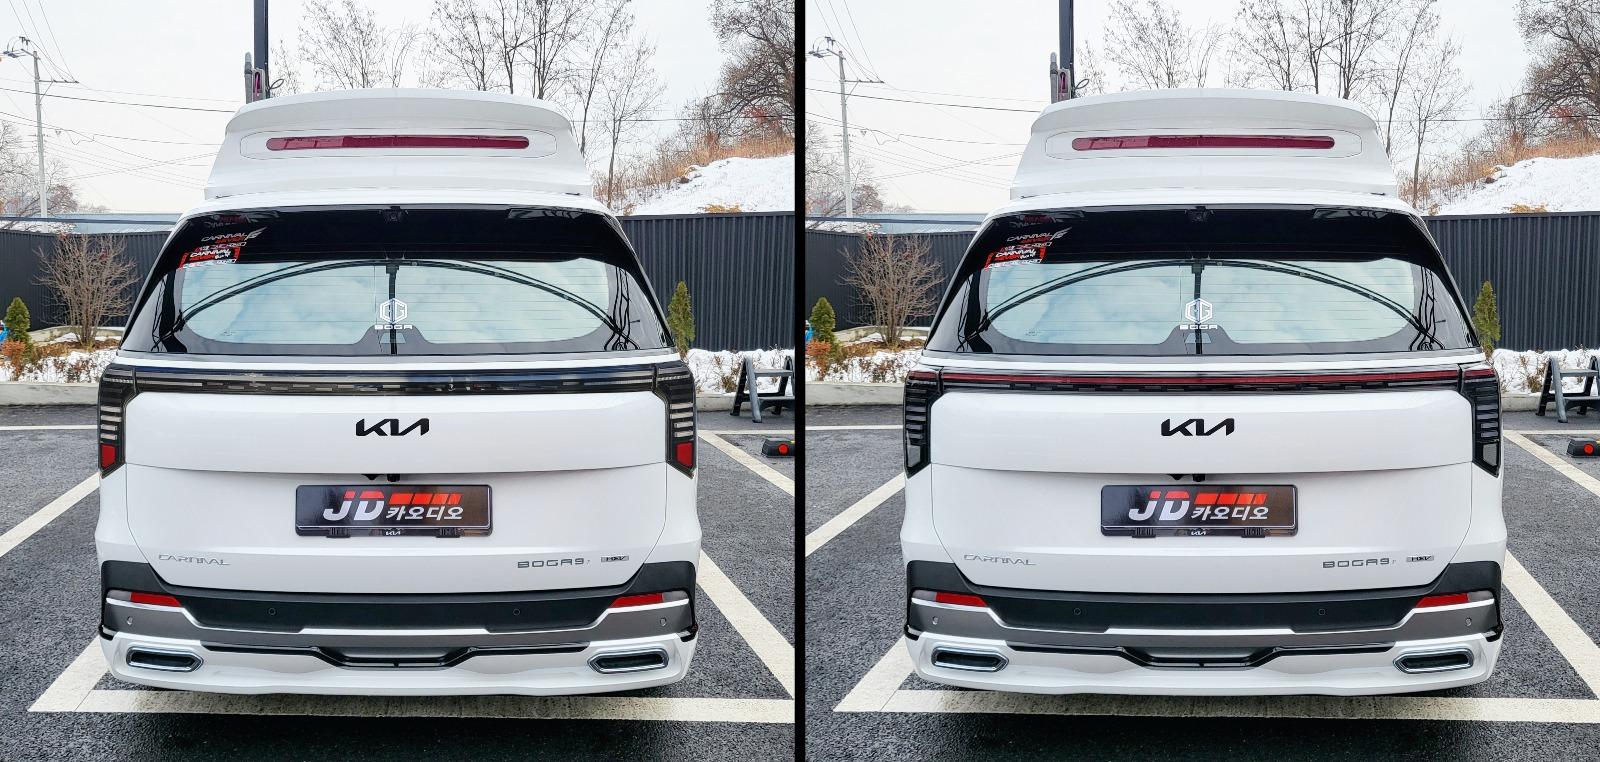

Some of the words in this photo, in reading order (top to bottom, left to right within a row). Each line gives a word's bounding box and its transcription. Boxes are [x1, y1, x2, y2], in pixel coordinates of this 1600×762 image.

[355, 418, 430, 437] KIA
[1160, 418, 1235, 437] KIA
[322, 490, 385, 521] JD
[386, 505, 464, 521] 카오디오
[1128, 490, 1190, 521] JD
[1191, 505, 1269, 521] 카오디오
[159, 554, 231, 566] CARNIVAL
[963, 554, 1037, 566] CARNIVAL
